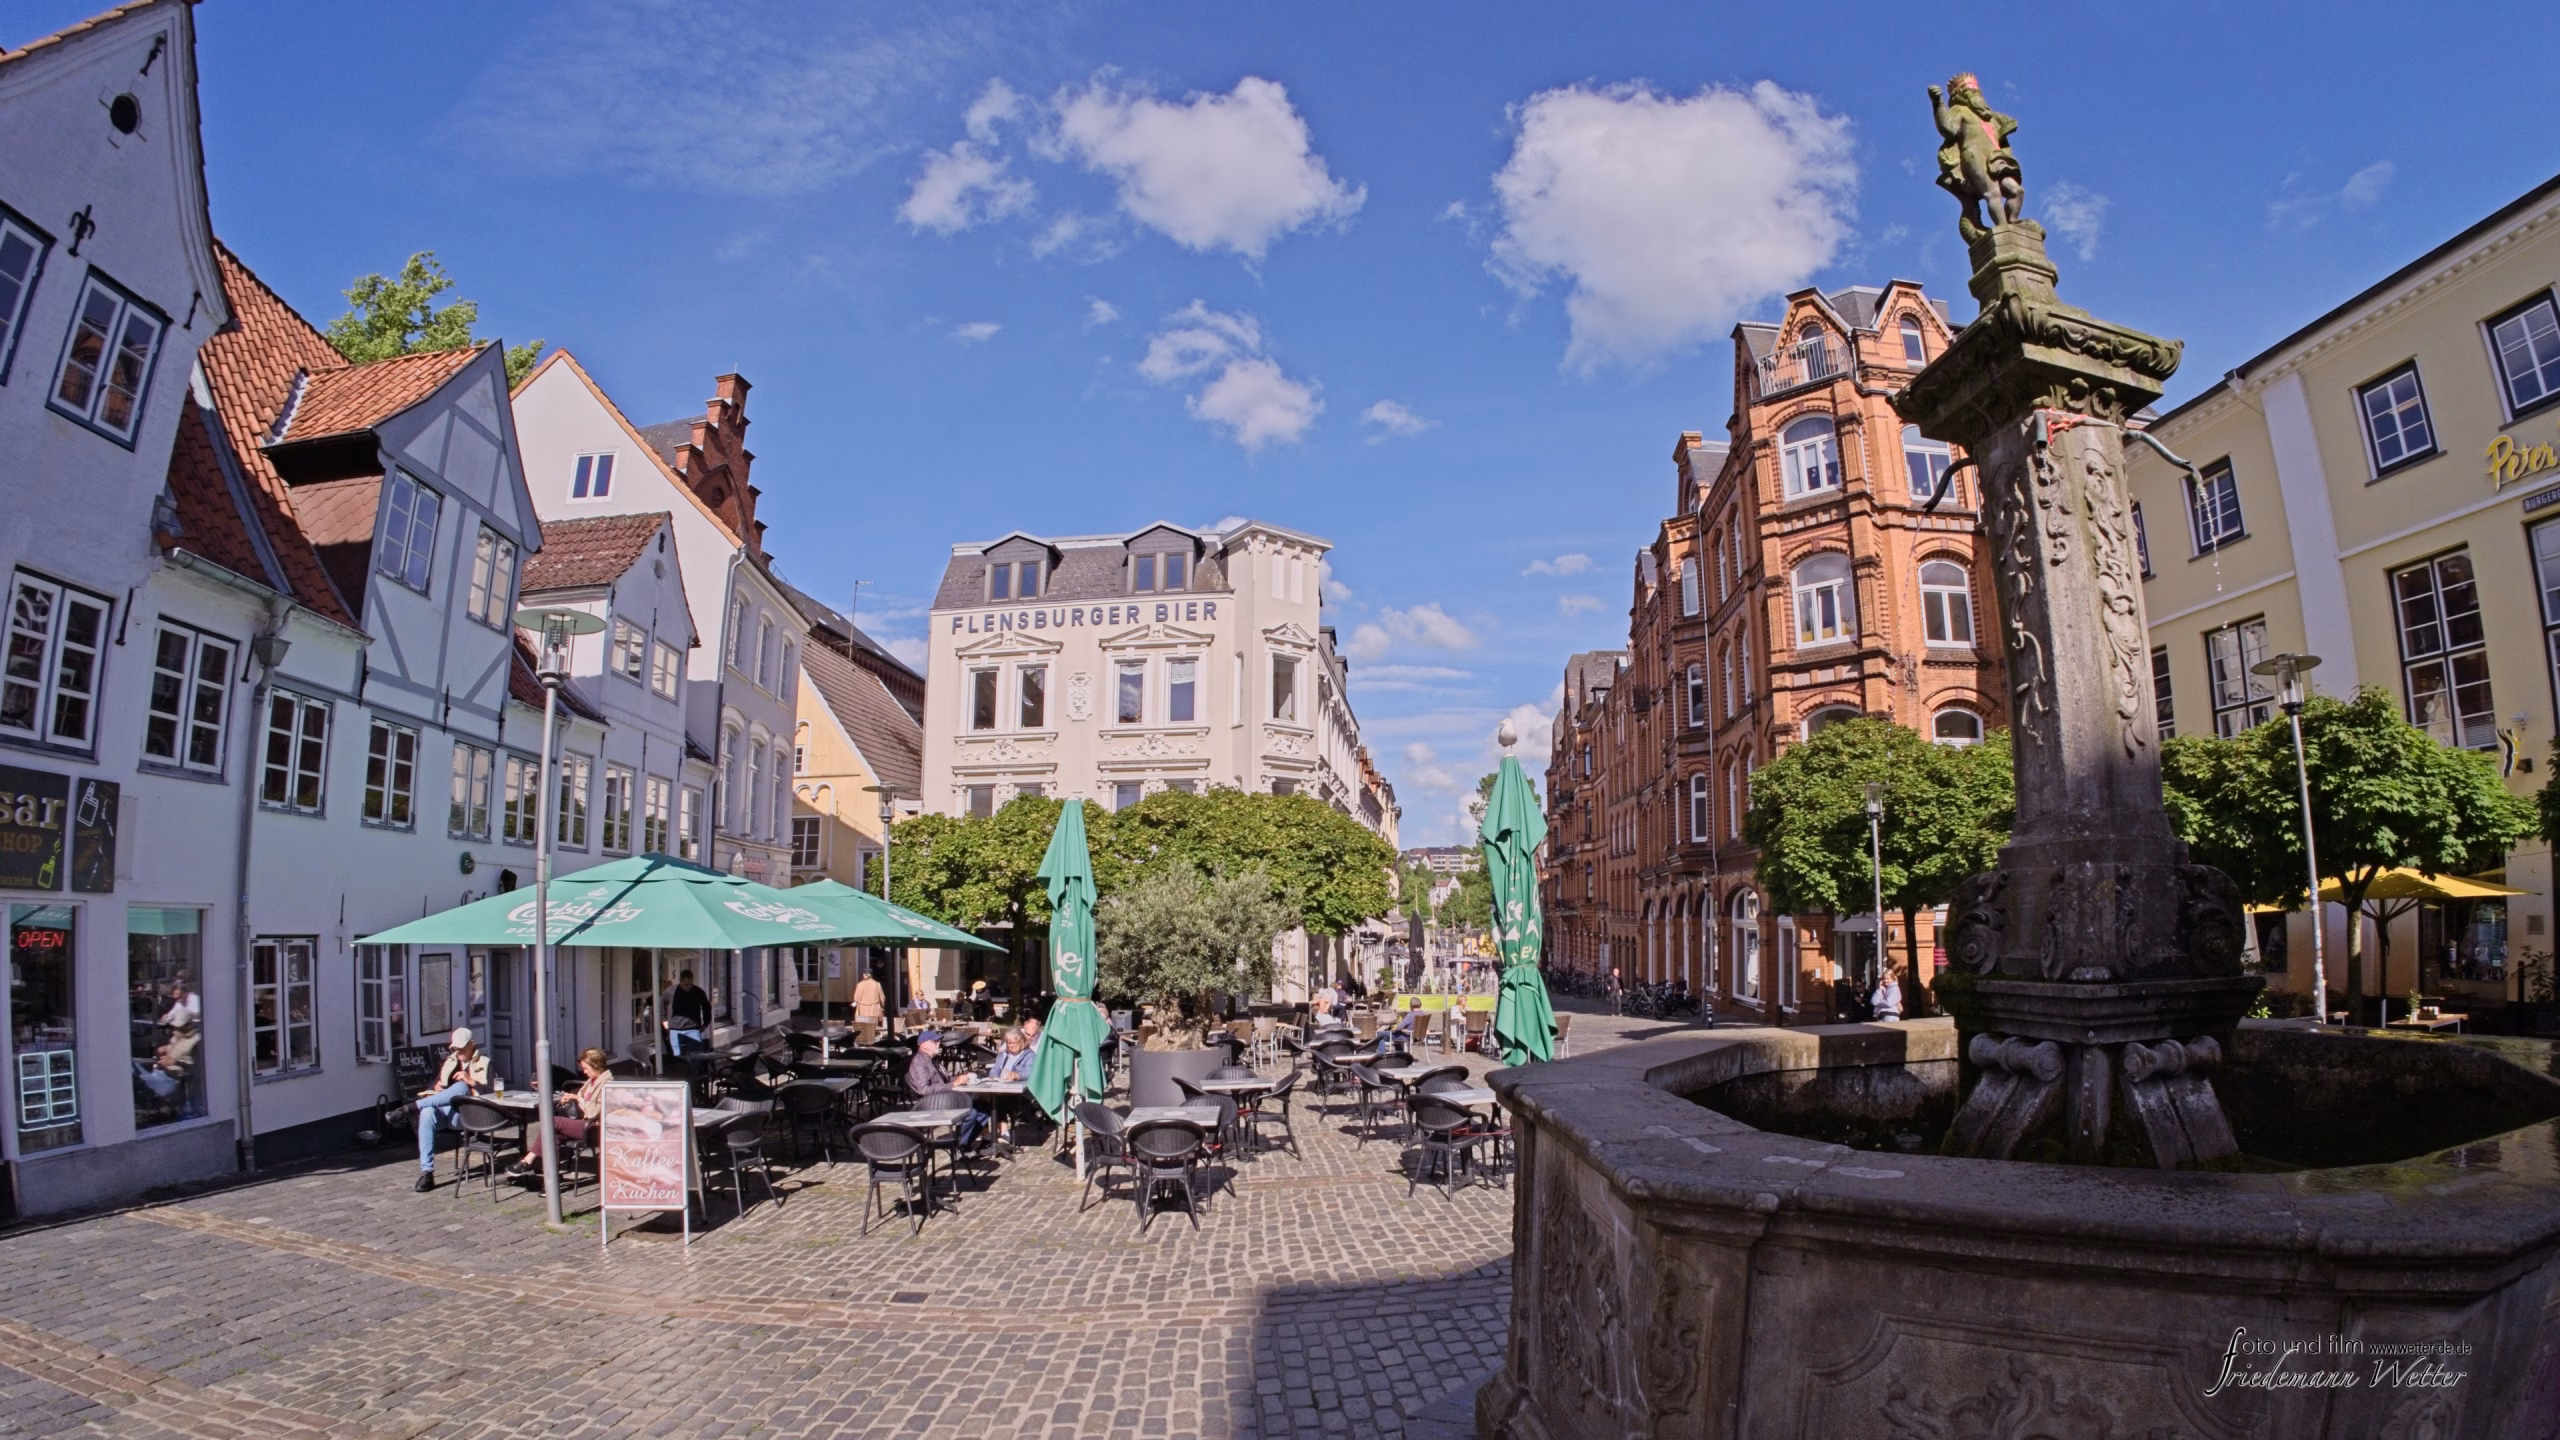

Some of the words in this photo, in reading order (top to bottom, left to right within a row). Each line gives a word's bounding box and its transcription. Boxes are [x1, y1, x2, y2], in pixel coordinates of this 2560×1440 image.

[2485, 435, 2558, 492] Peter
[952, 605, 1140, 634] FLENSBURGER
[1155, 601, 1217, 622] BIER
[18, 931, 65, 948] OPEN
[609, 1146, 677, 1169] Kaffee
[609, 1180, 679, 1200] Kuchen
